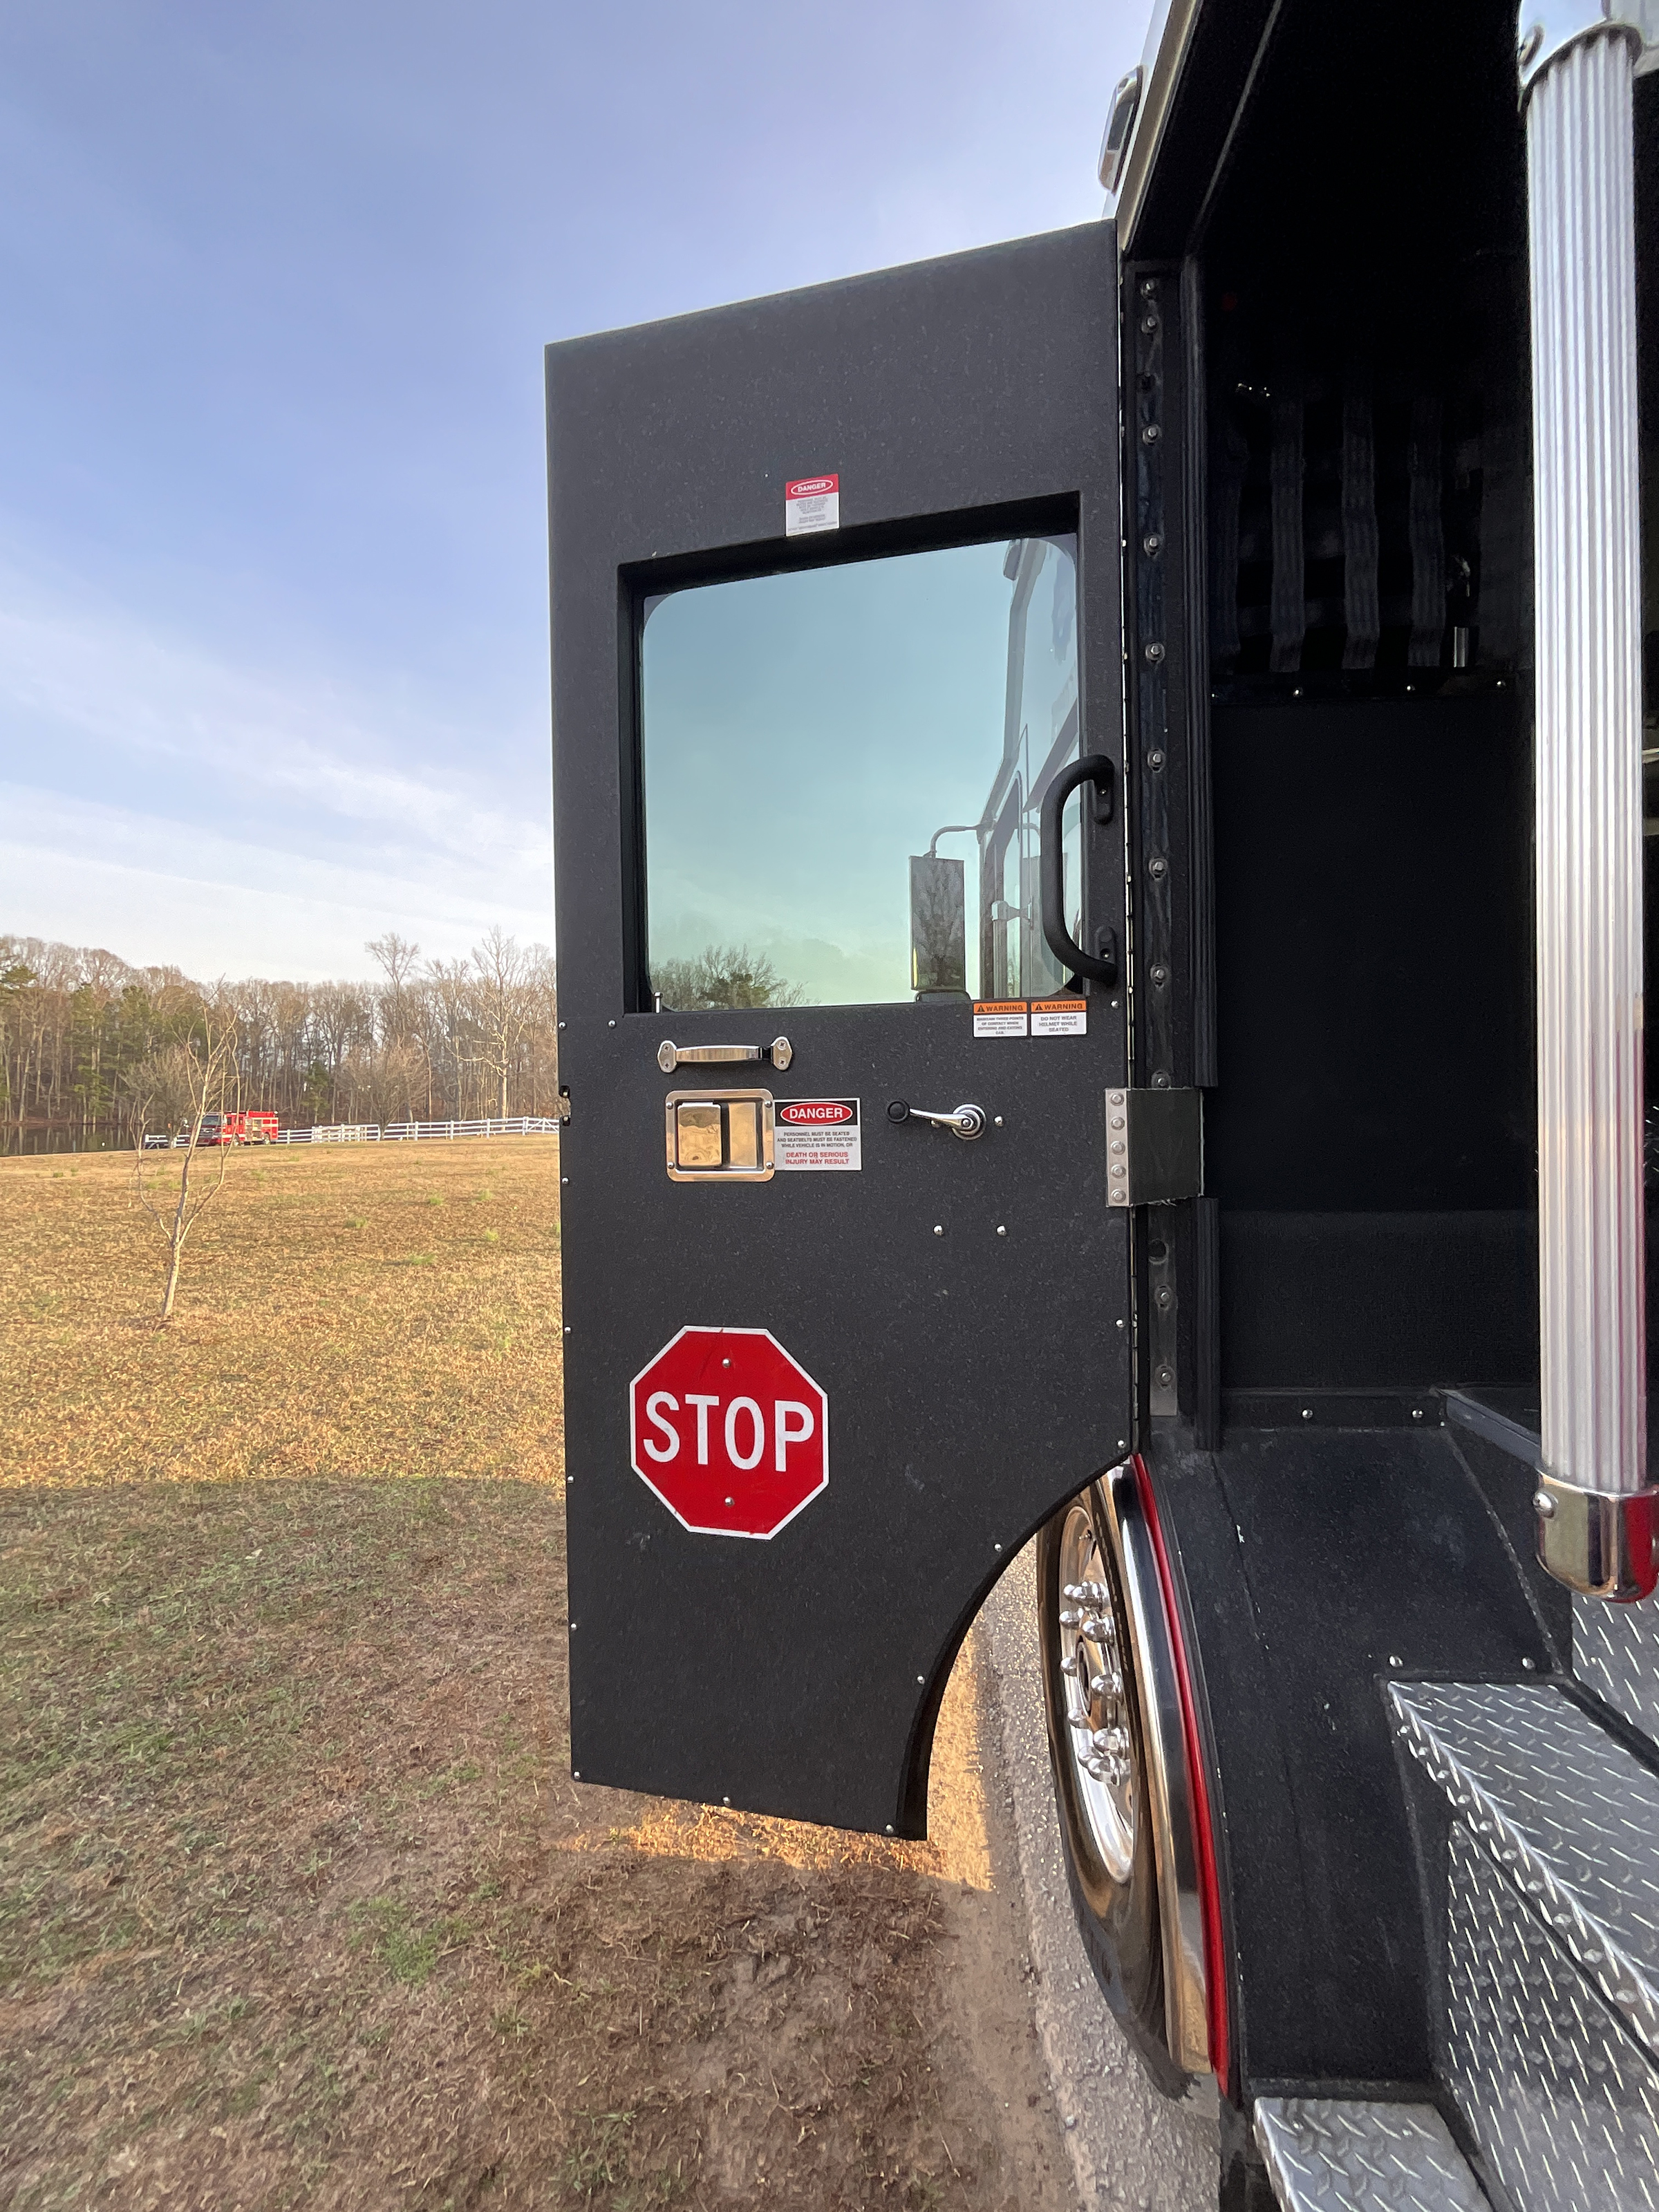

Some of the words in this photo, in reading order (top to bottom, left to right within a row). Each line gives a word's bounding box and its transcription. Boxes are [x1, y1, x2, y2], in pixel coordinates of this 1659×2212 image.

[798, 482, 826, 492] DANGER
[789, 1107, 843, 1118] DANGER
[644, 1391, 814, 1472] STOP
